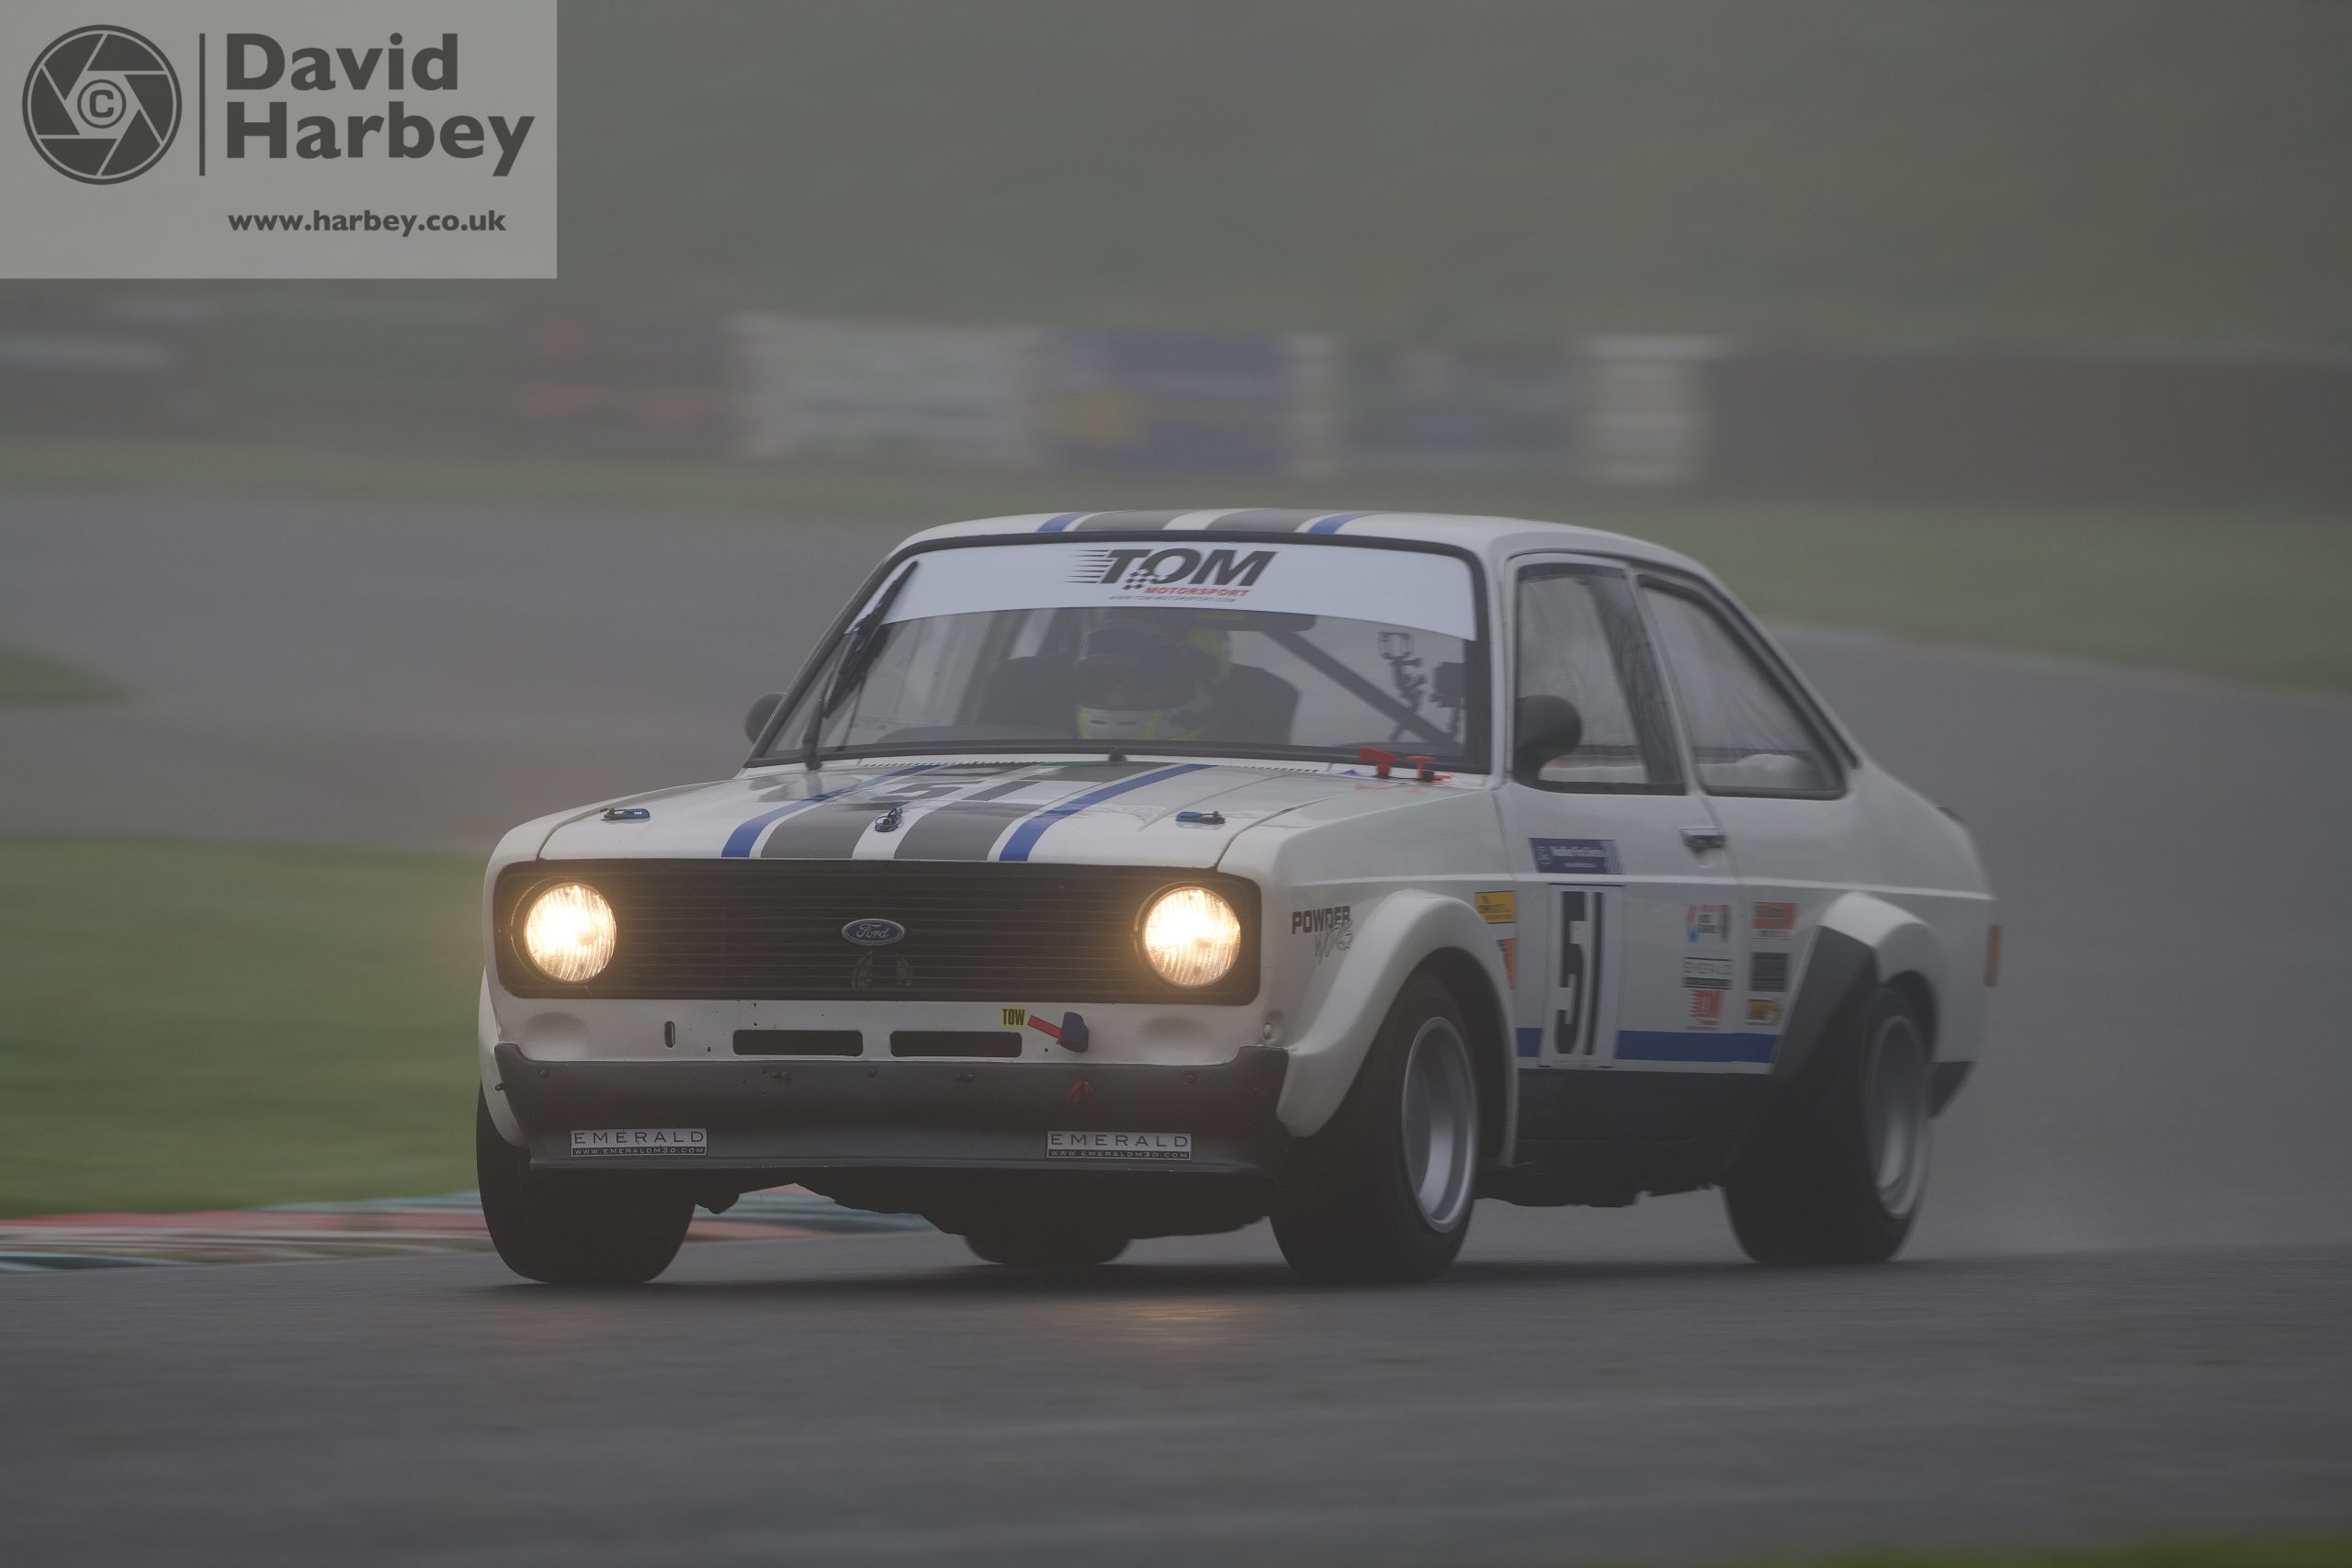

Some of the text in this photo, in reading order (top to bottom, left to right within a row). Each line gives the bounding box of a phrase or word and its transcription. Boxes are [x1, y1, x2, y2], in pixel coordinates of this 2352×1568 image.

[1100, 547, 1280, 587] TOM
[1144, 586, 1250, 597] MOTORSPORT
[1291, 905, 1351, 935] POWDER
[855, 922, 890, 939] Ford
[1553, 890, 1605, 1055] 51
[1001, 1008, 1025, 1026] TOW
[574, 1131, 705, 1145] EMERALD
[1050, 1133, 1189, 1147] EMERALD
[574, 1146, 705, 1155] WWW.EMERALDM3D.COM
